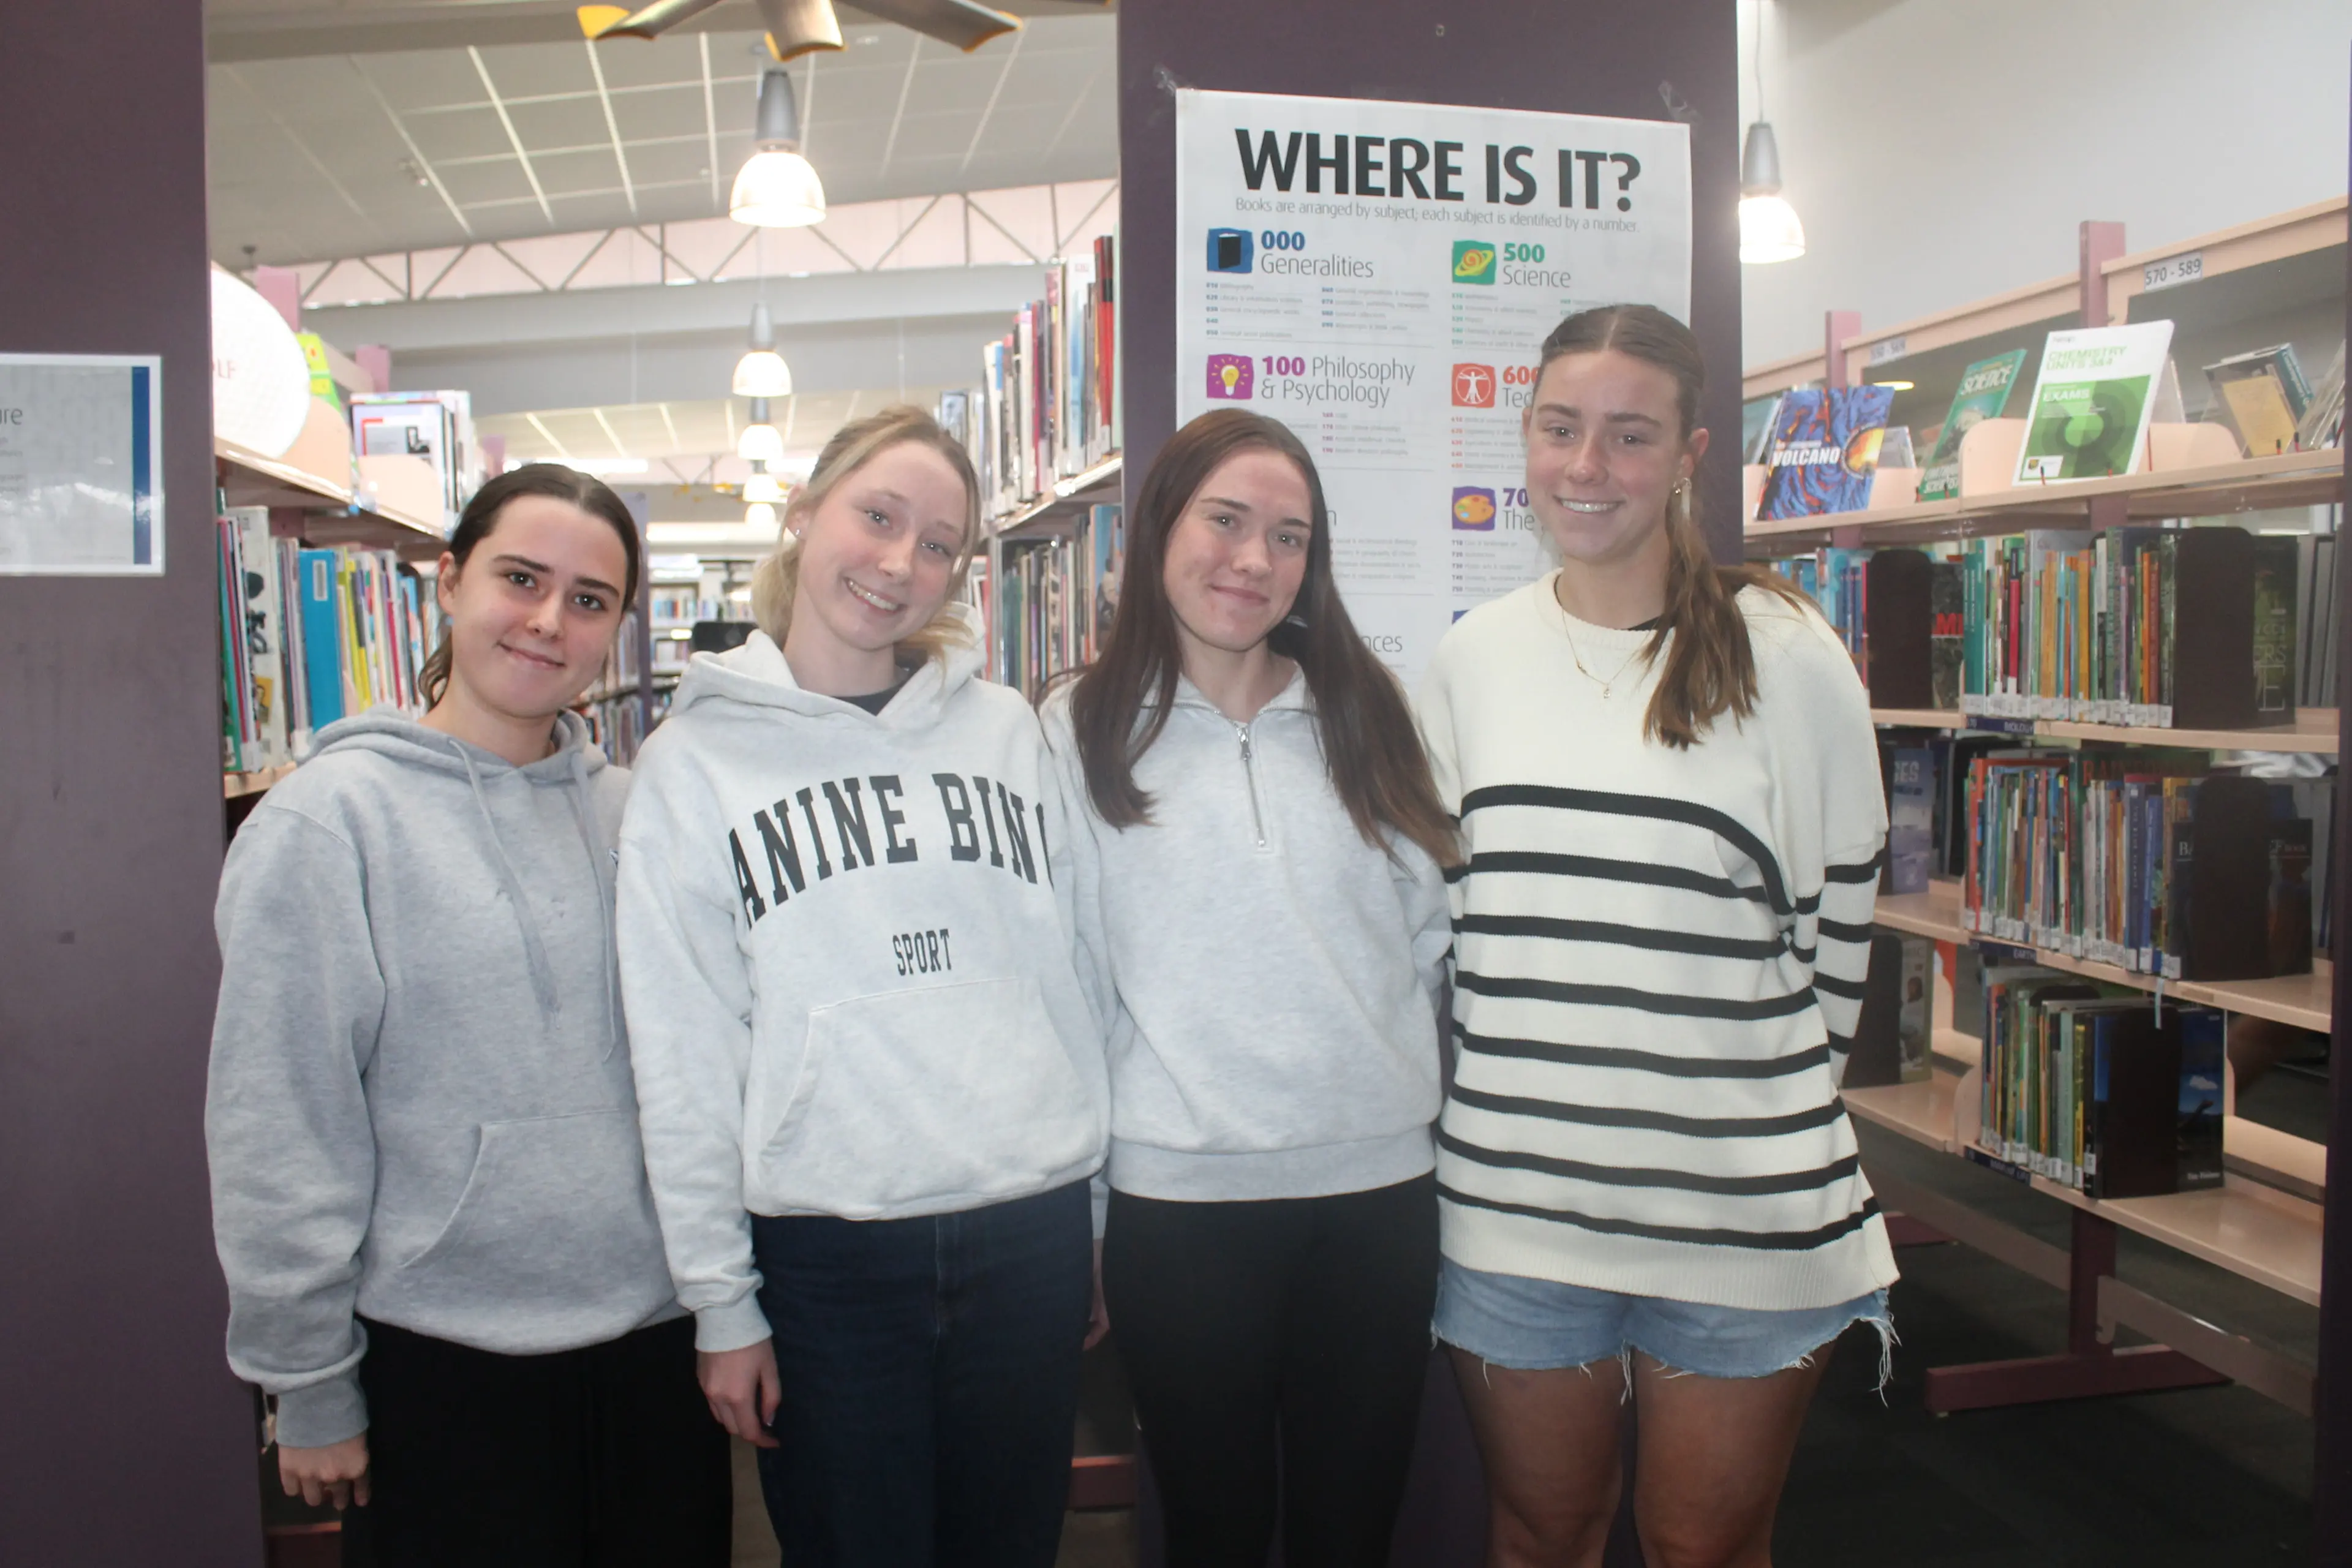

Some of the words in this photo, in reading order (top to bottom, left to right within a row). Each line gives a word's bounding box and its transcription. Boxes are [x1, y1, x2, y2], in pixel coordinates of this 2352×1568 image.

[1235, 128, 1464, 200] WHERE
[1485, 144, 1537, 206] IS
[1558, 149, 1641, 212] IT?
[1235, 197, 1272, 212] Books
[1276, 202, 1295, 213] are
[1299, 202, 1352, 219] arranged
[1356, 203, 1371, 221] by
[1422, 207, 1450, 221] each
[1453, 209, 1493, 225] subject
[1498, 211, 1506, 224] is
[1509, 211, 1562, 228] identified
[1565, 214, 1580, 232] by
[1583, 218, 1590, 230] a
[1593, 217, 1640, 233] number.
[1261, 230, 1306, 251] 000
[1504, 243, 1545, 263] 500
[1261, 253, 1374, 278] Generalities
[1503, 264, 1571, 288] Science
[2146, 266, 2167, 286] 570
[2178, 258, 2201, 277] 589
[2048, 345, 2127, 362] CHEMISTRY
[1262, 356, 1306, 376] 100
[1313, 355, 1415, 386] Philosophy
[1261, 378, 1276, 399] &
[1283, 379, 1390, 409] Psychology
[2043, 388, 2090, 402] EXAMS
[1772, 446, 1841, 467] VOLCANO
[1502, 508, 1536, 531] The
[728, 774, 918, 930] ANINE
[892, 928, 952, 977] SPORT
